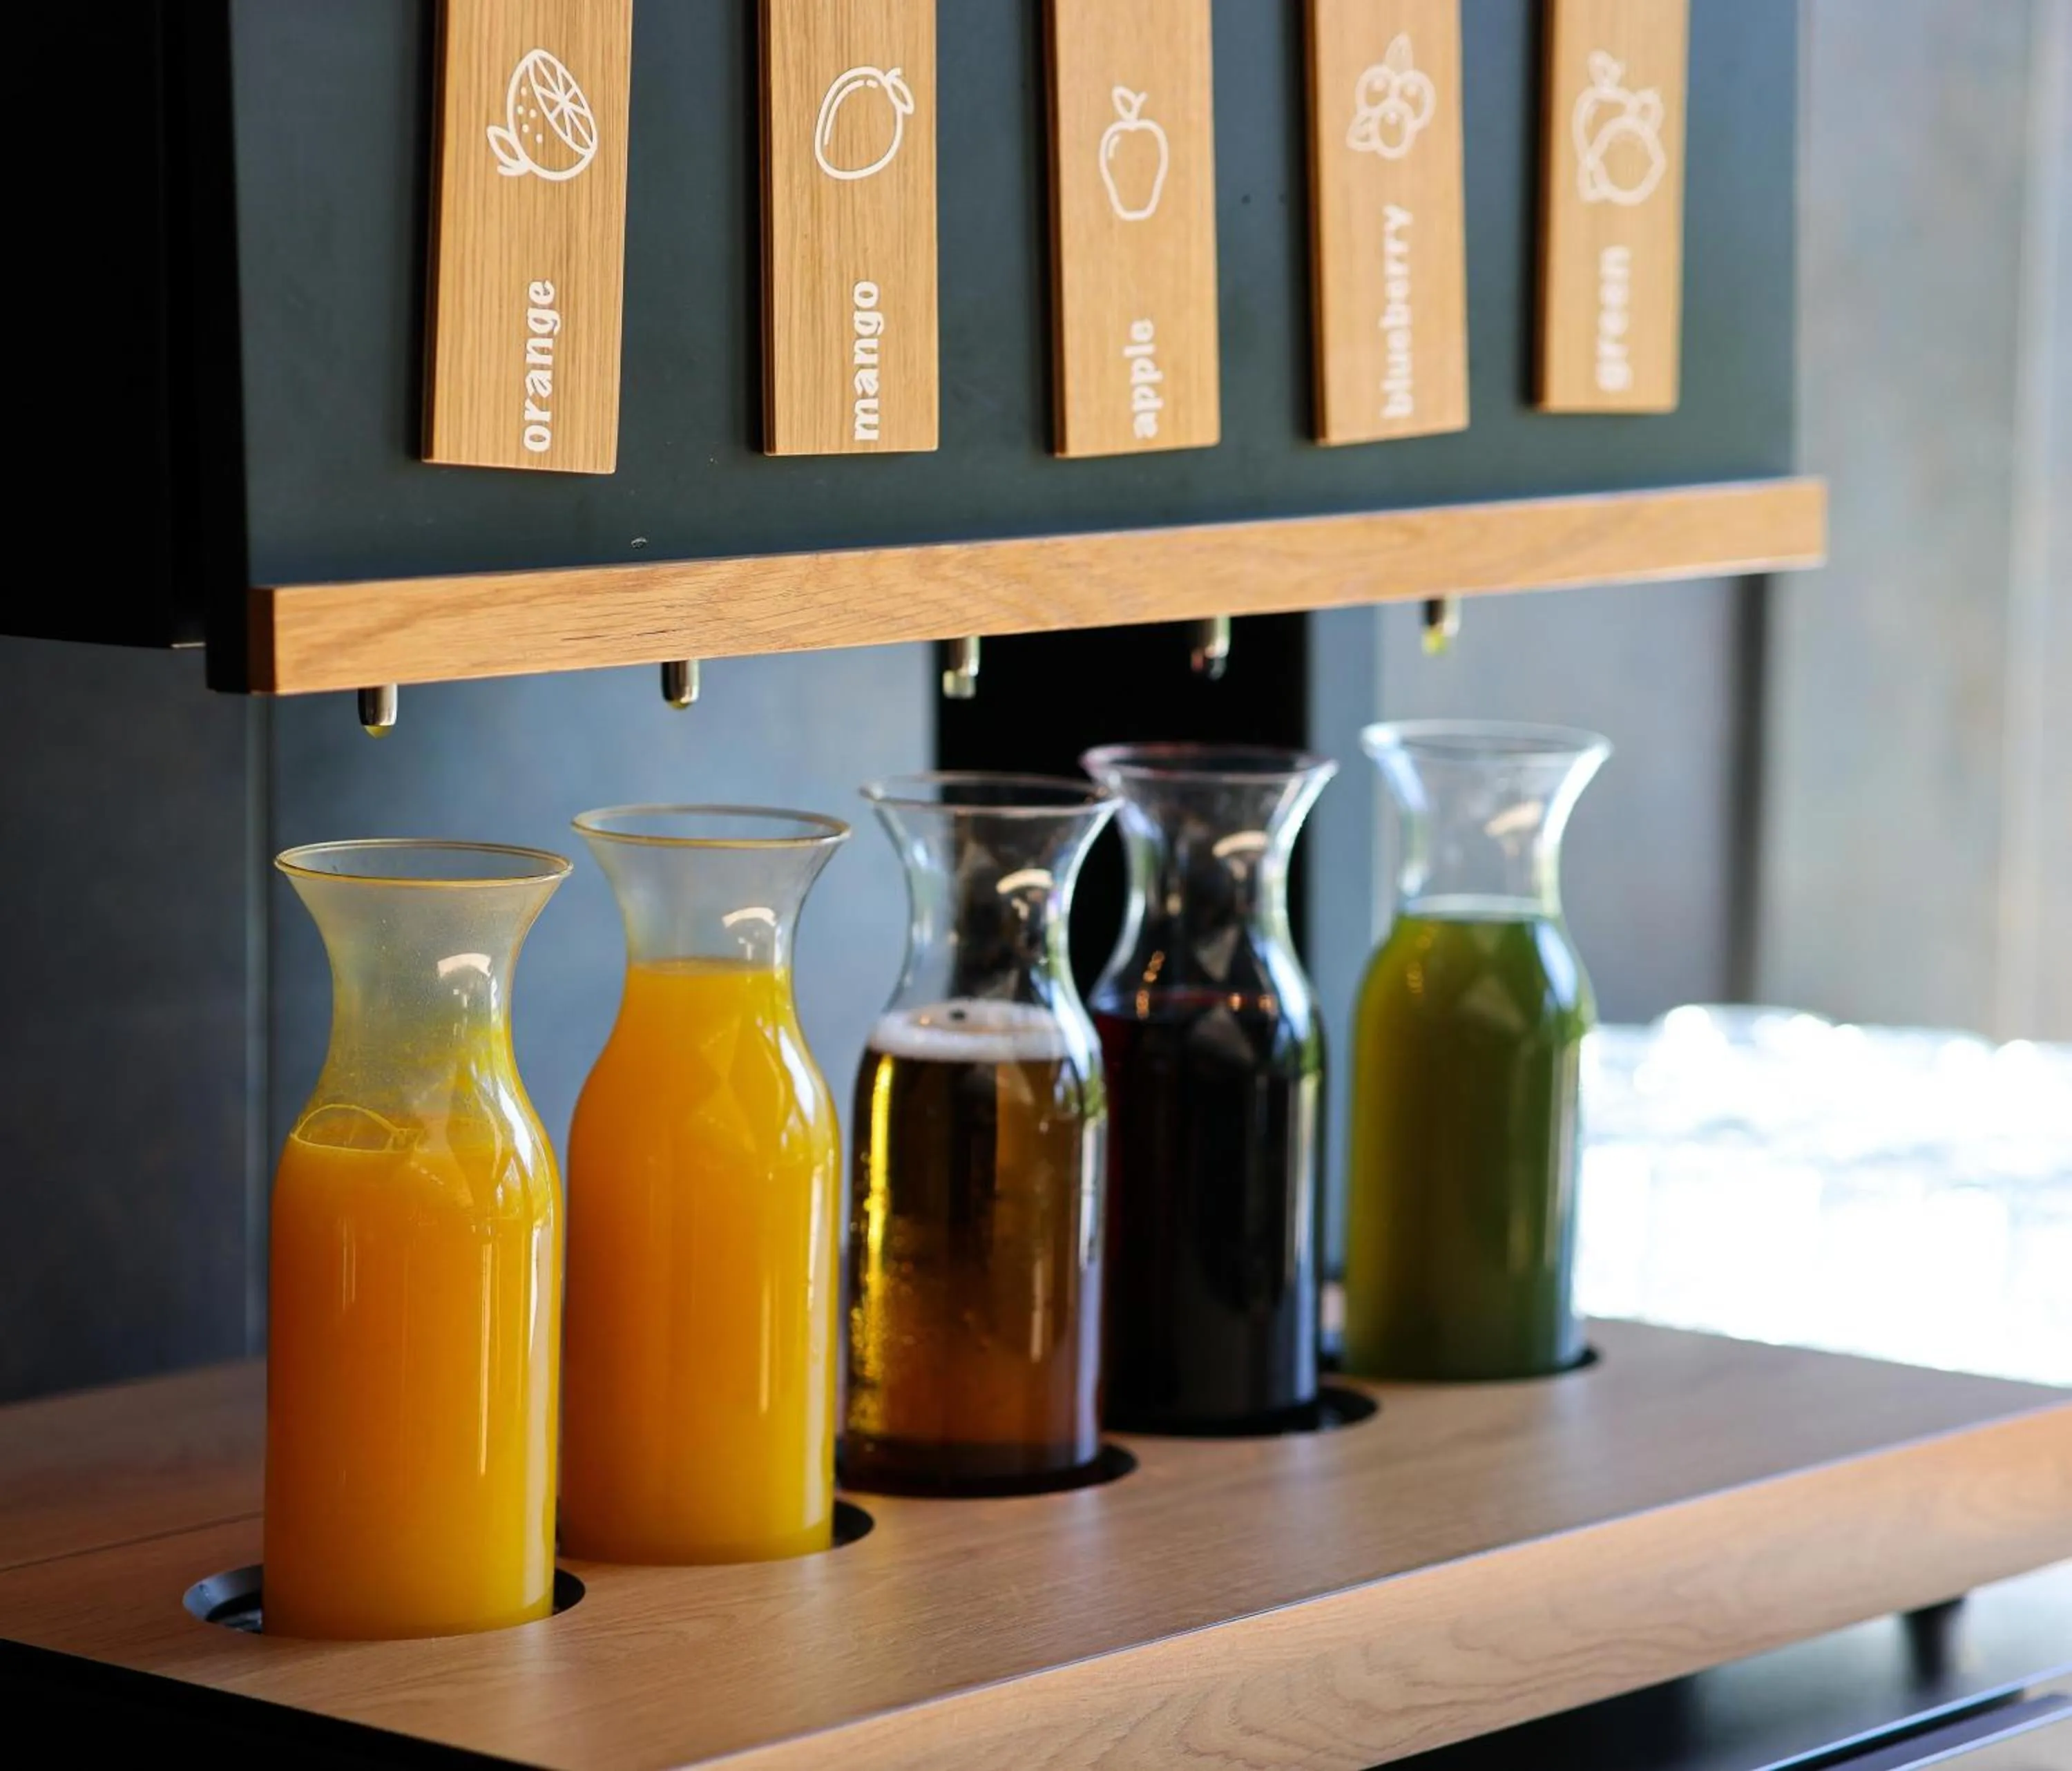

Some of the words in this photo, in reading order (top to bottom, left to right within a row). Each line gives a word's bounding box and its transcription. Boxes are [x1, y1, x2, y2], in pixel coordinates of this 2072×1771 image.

[523, 280, 561, 452] orange
[853, 280, 885, 441] mango
[1123, 318, 1164, 439] apple
[1379, 205, 1414, 419] blueberry
[1595, 246, 1633, 392] green
